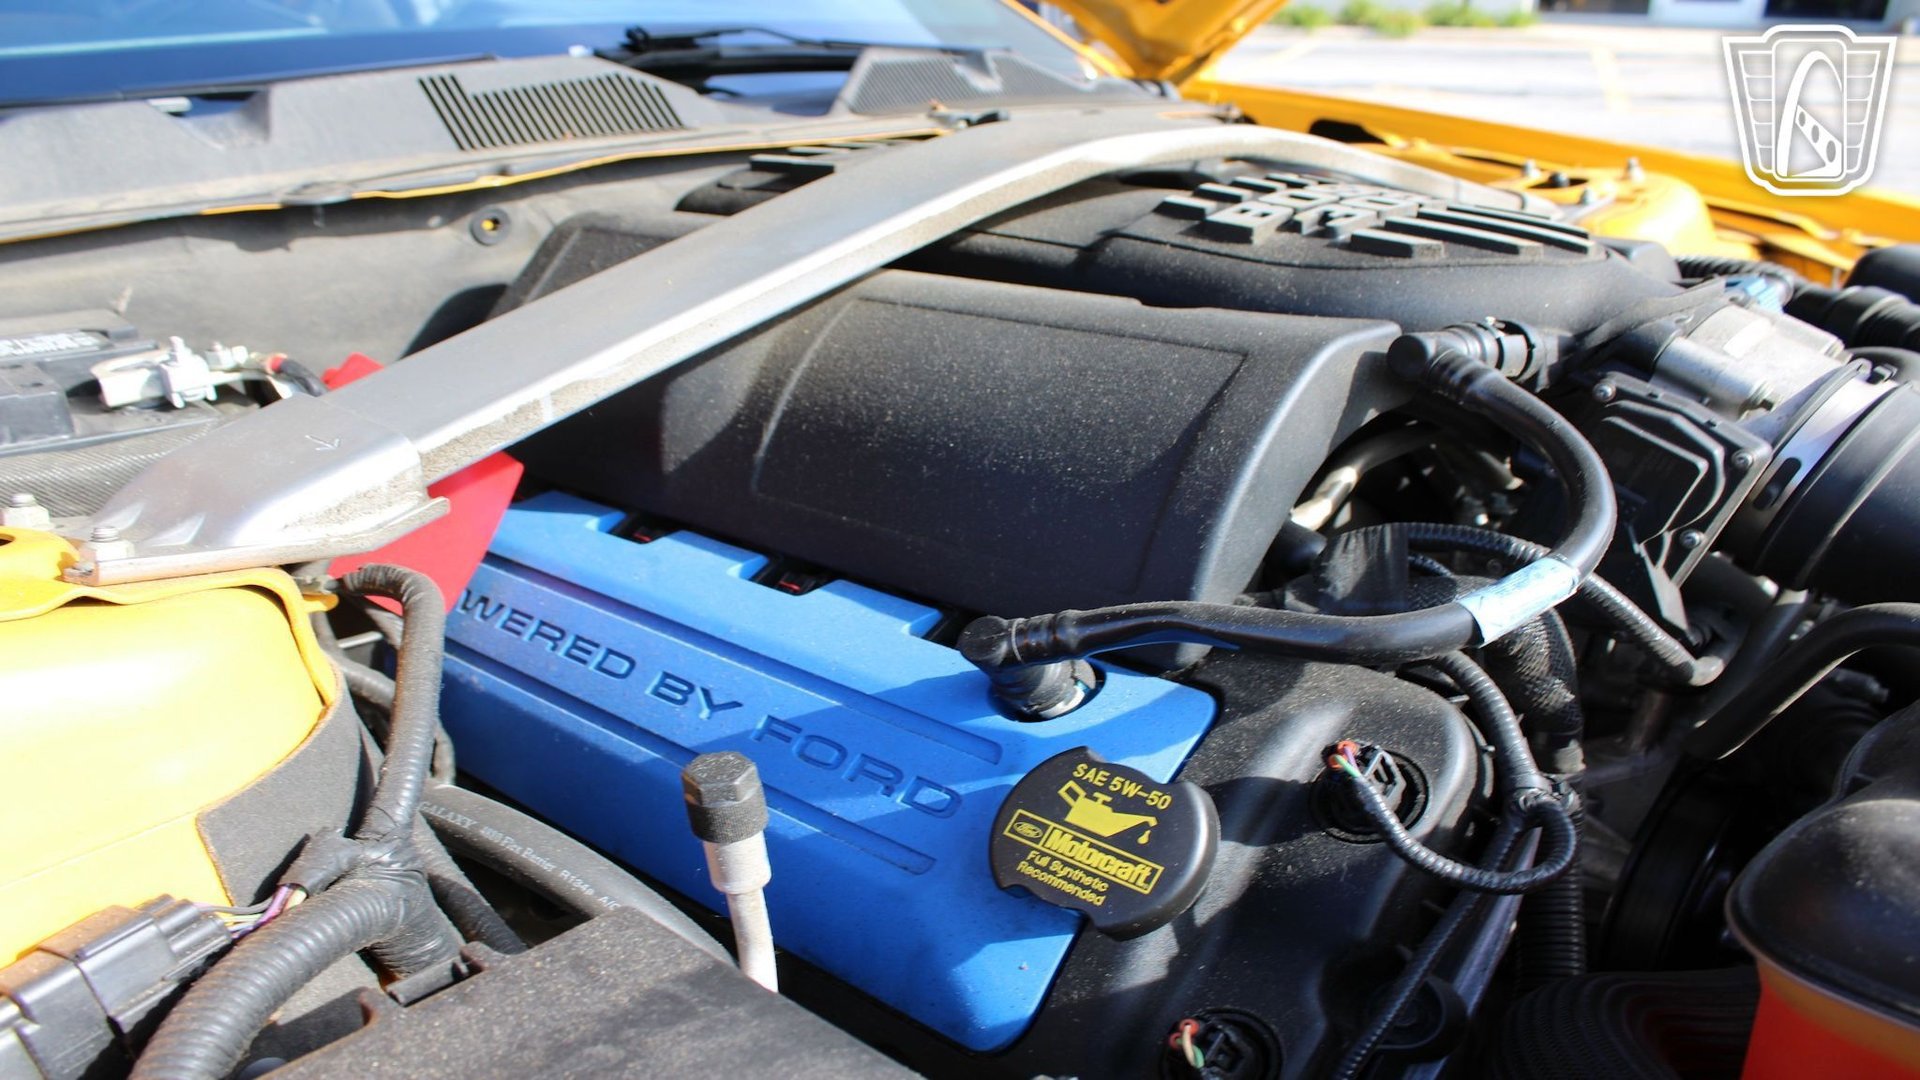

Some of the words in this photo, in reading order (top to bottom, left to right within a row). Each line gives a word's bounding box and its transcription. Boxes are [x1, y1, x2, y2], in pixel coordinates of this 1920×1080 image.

[456, 587, 636, 681] WERED
[646, 669, 743, 719] BY
[751, 714, 962, 819] FORD
[1072, 763, 1110, 787] SAE
[1108, 776, 1172, 811] 5W-50
[418, 801, 478, 830] GALAXY
[1013, 821, 1044, 839] Ford
[1044, 829, 1153, 886] Motorcraft
[1026, 850, 1049, 869] Full
[1050, 858, 1110, 893] Synthetic
[1016, 861, 1106, 907] Recommended
